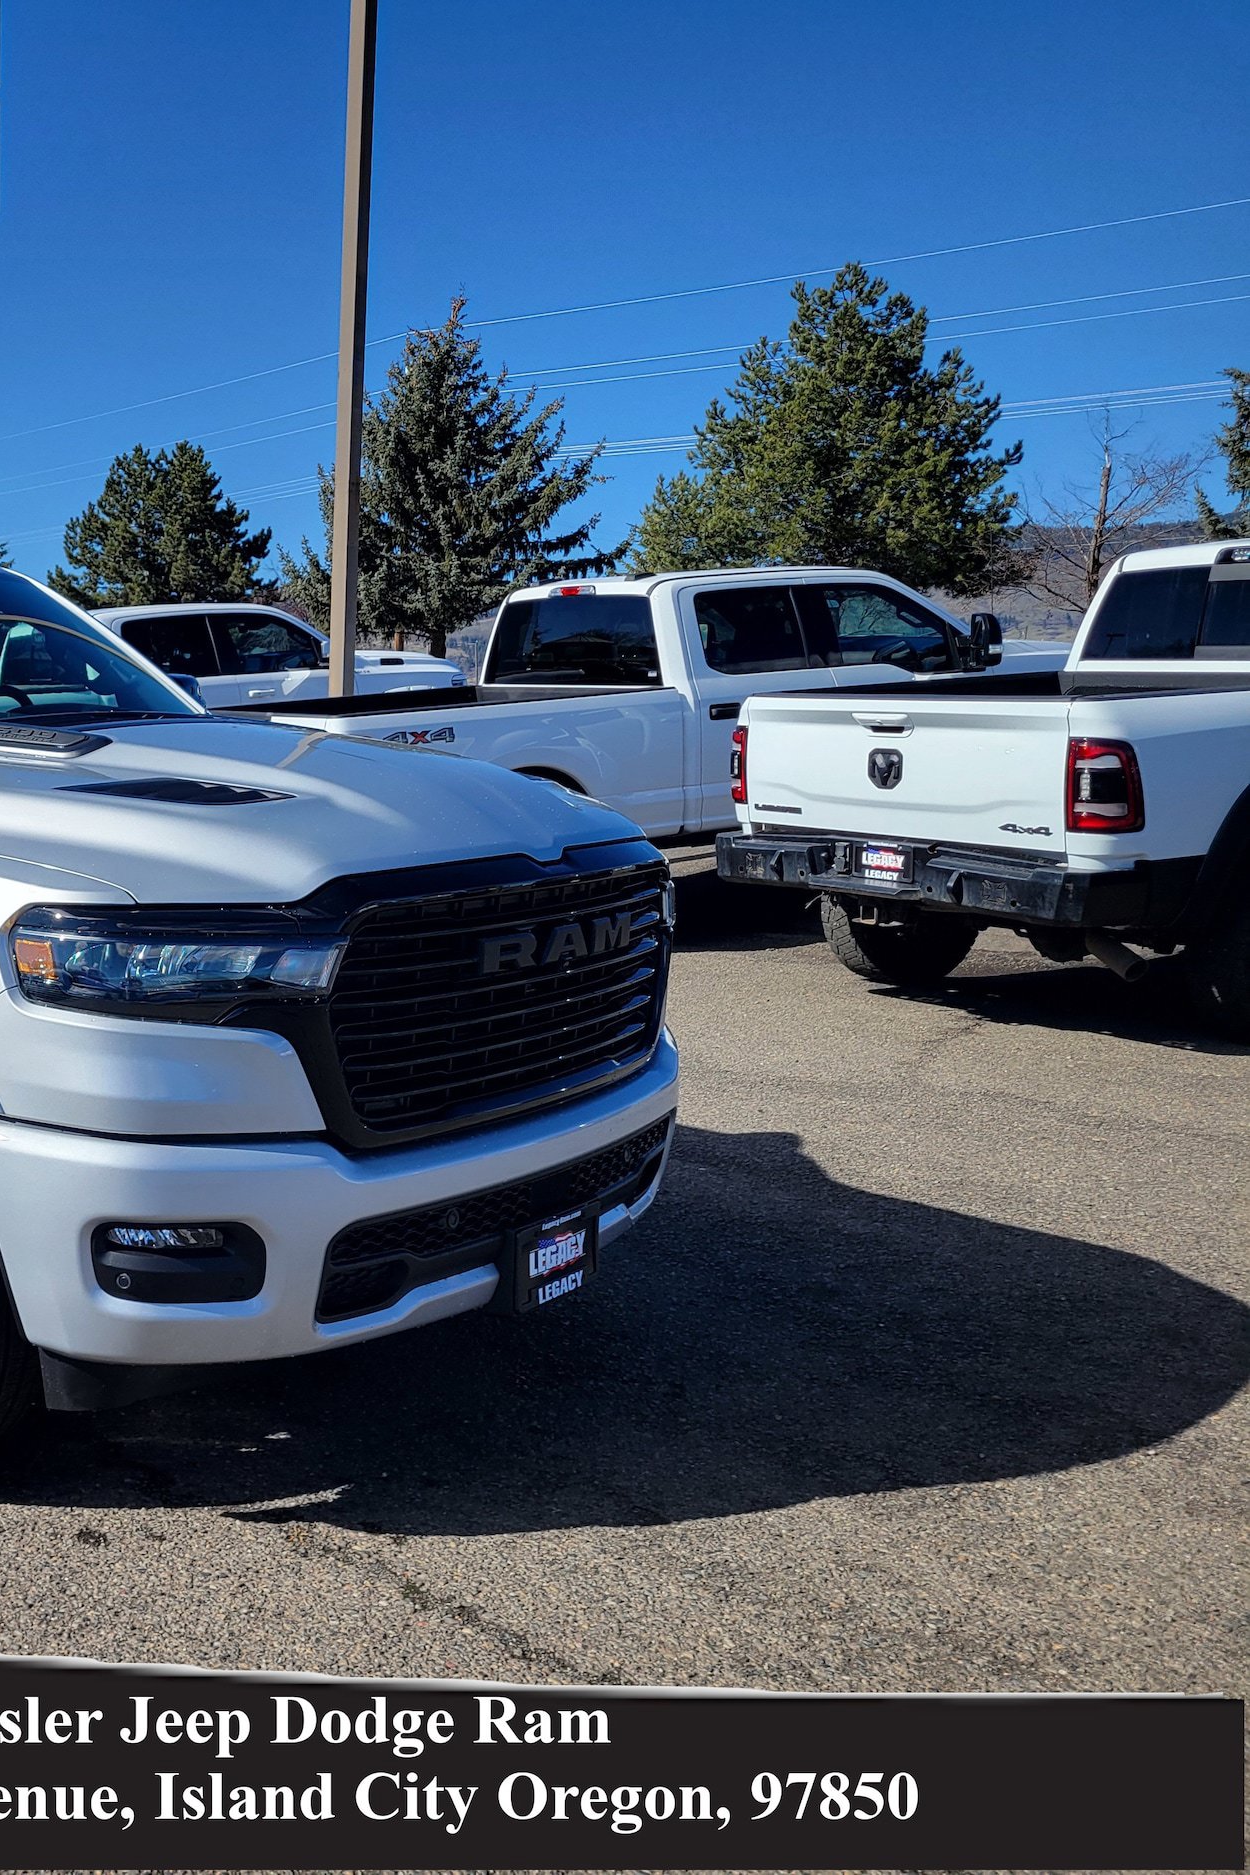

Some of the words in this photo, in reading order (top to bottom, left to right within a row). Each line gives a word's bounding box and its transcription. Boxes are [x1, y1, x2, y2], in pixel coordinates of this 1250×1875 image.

[862, 850, 906, 868] LEGACY
[864, 868, 900, 881] LEGACY
[479, 911, 632, 974] RAM
[529, 1230, 587, 1277] LEGACY
[538, 1269, 584, 1305] LEGACY
